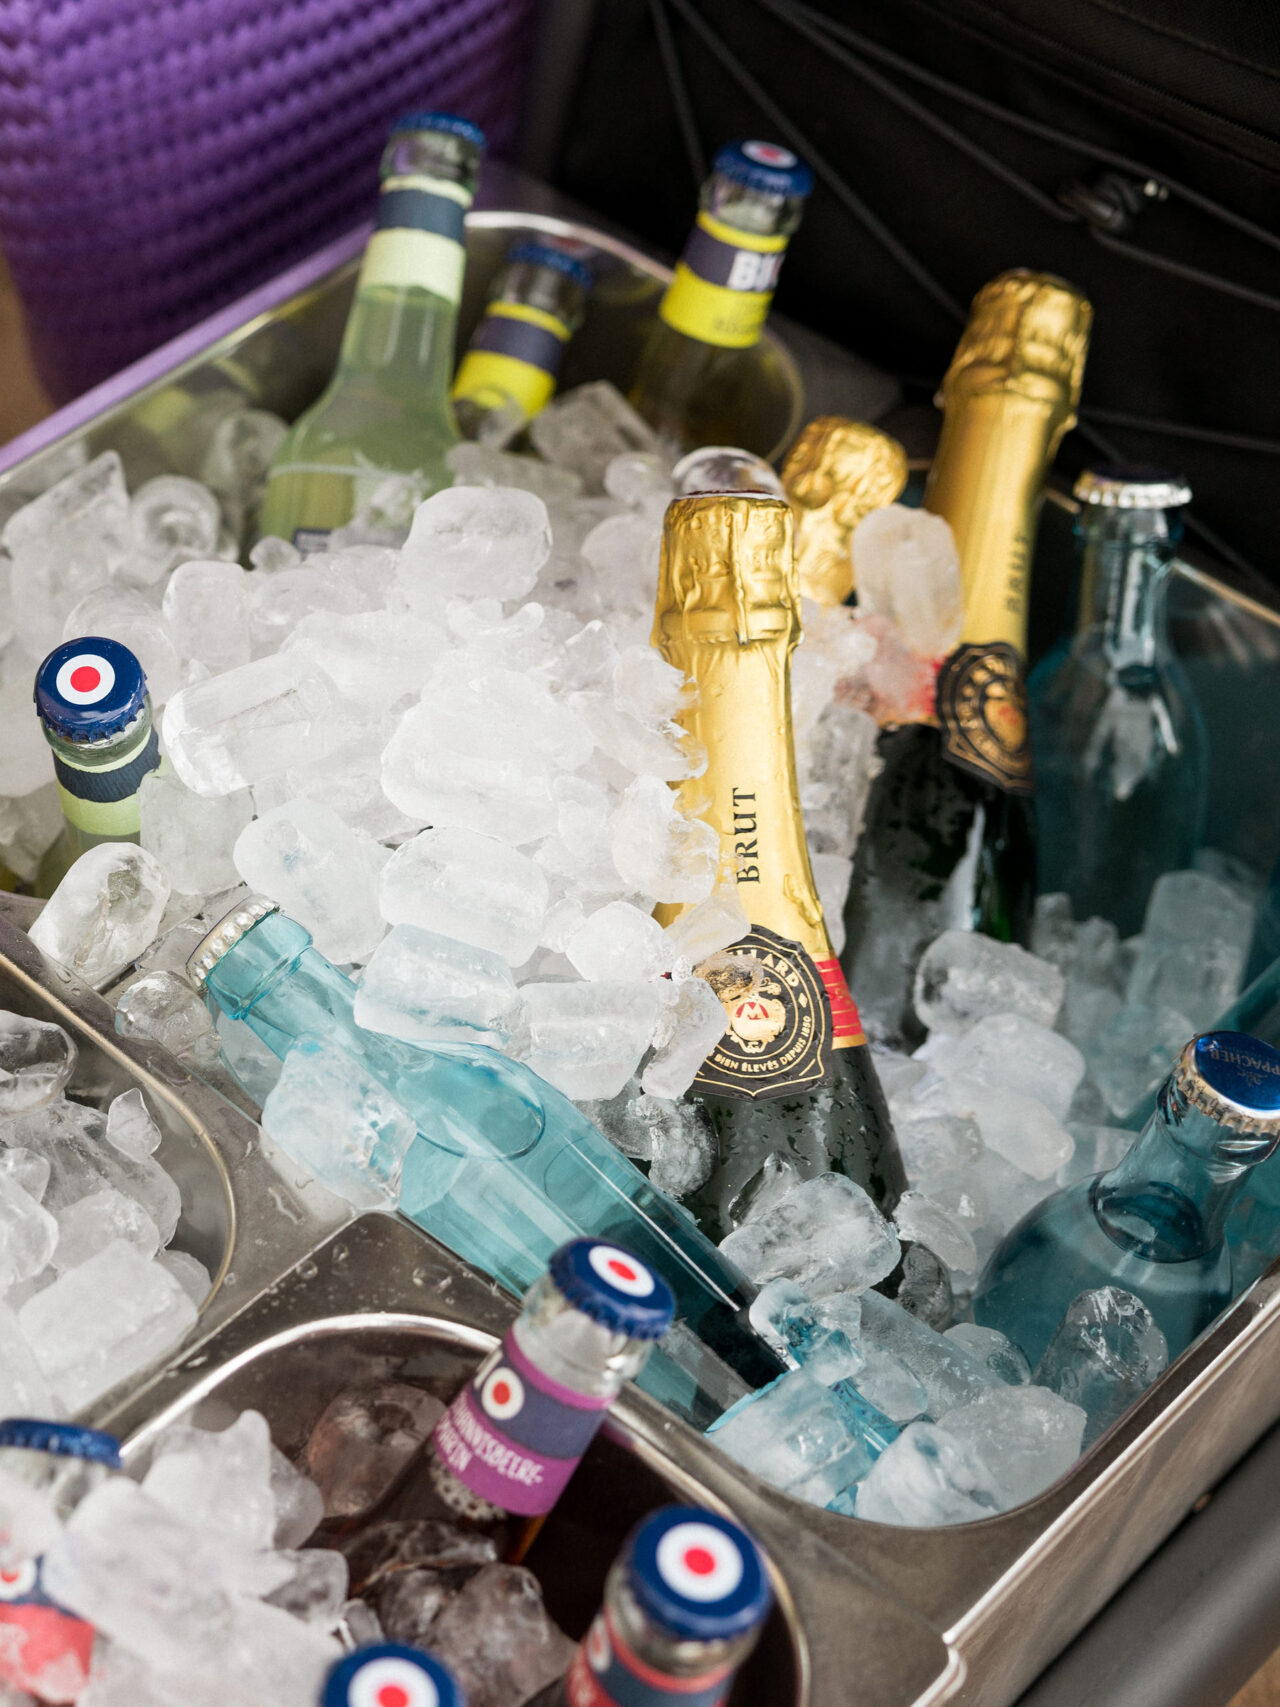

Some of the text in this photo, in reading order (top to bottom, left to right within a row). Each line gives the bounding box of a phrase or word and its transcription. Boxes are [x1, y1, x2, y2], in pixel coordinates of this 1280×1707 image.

[732, 787, 760, 884] BRUT
[714, 1053, 739, 1069] BIEN
[741, 1057, 780, 1072] ÉLEVÉS
[779, 1038, 807, 1066] DEPUIS
[1210, 1050, 1280, 1076] PPACHER
